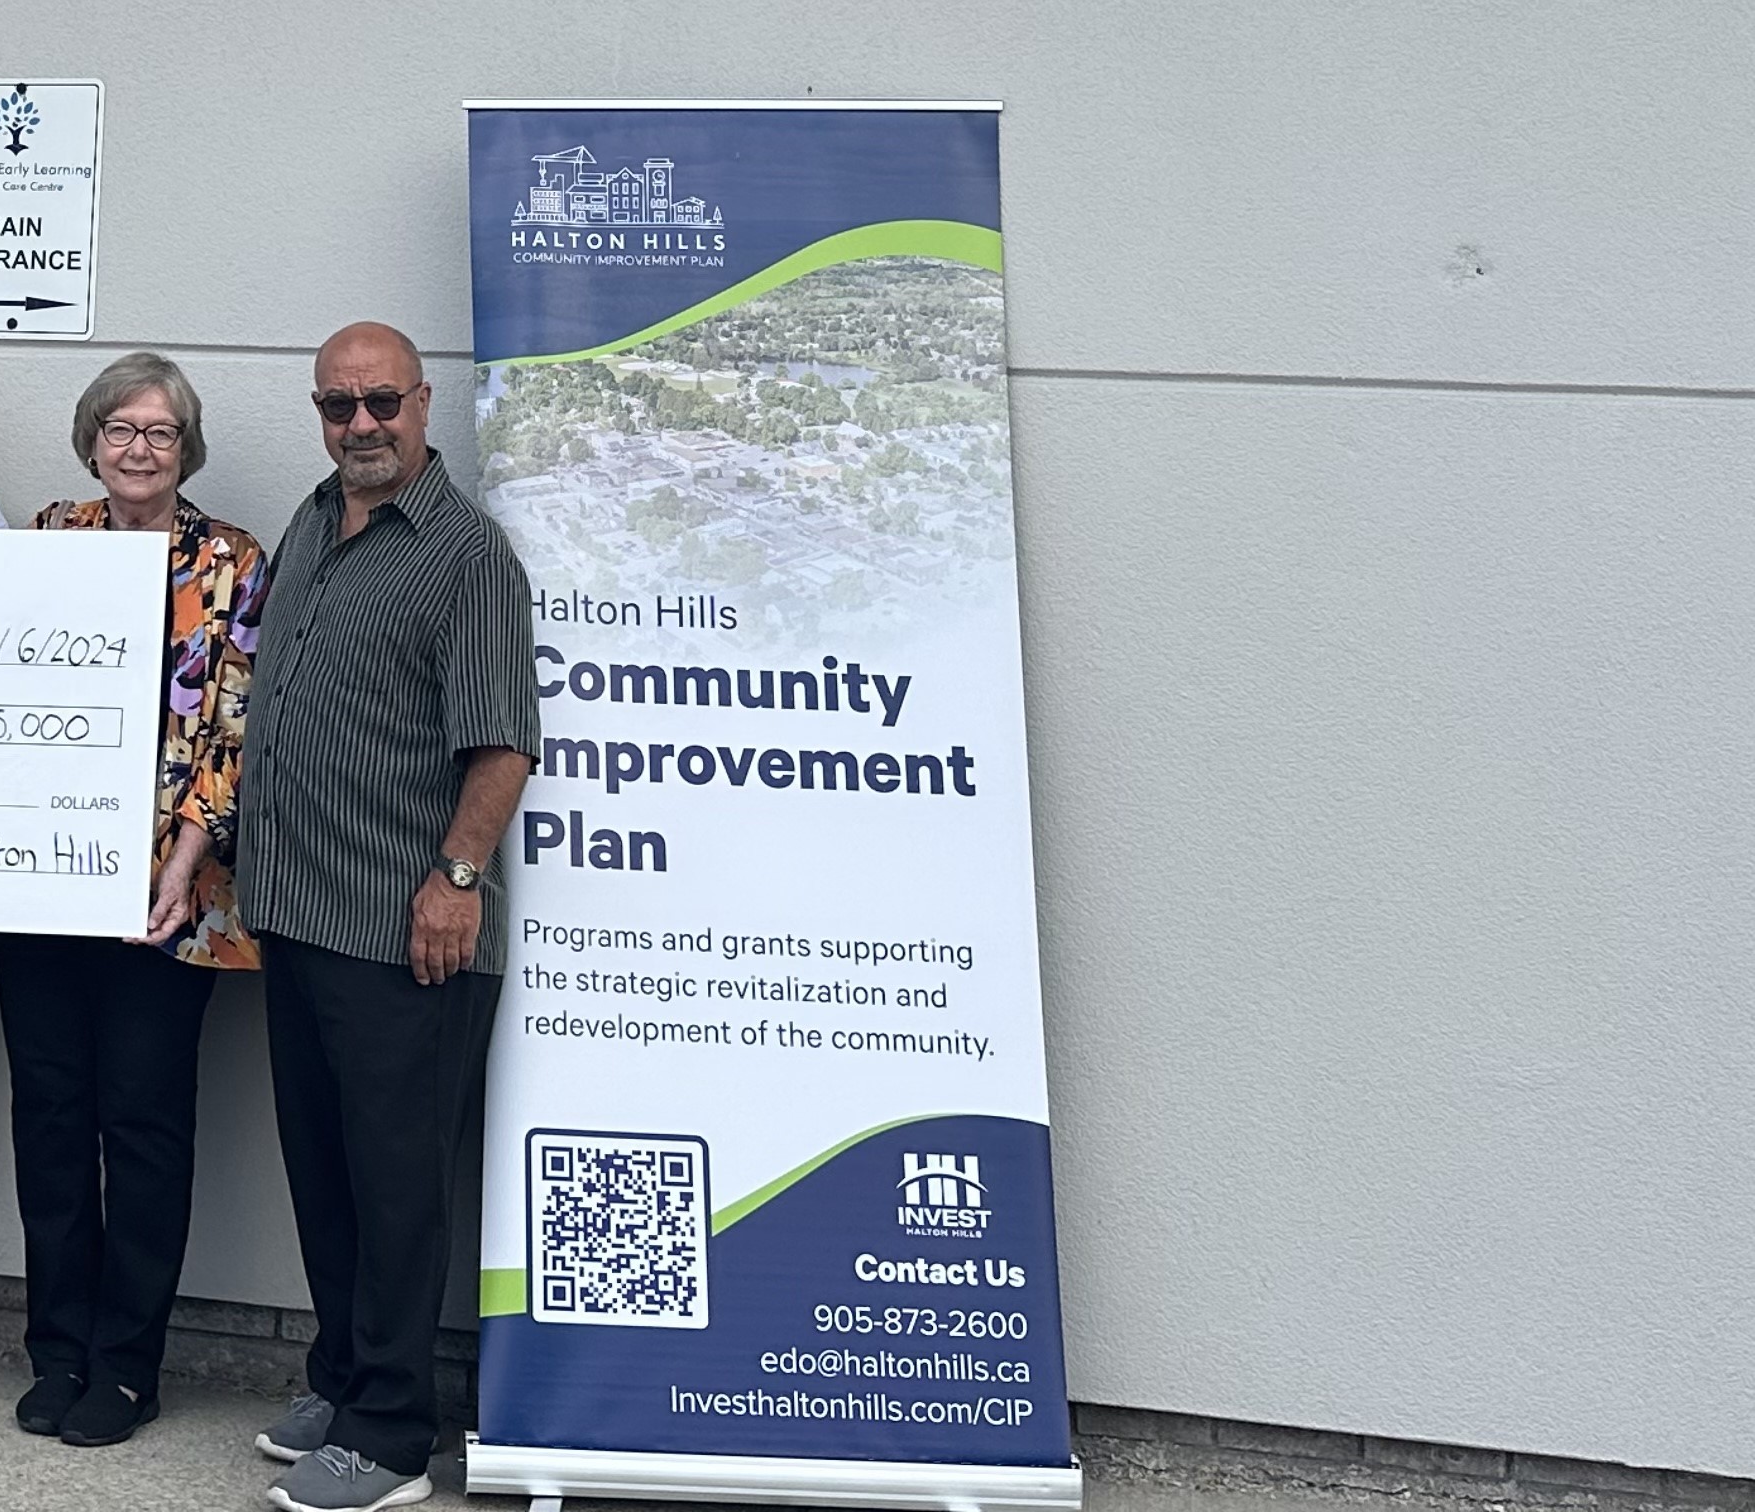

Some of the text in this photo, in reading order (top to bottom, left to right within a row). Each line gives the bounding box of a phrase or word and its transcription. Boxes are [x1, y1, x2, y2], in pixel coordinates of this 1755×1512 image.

[2, 181, 26, 191] Care
[30, 181, 64, 192] Centre
[34, 163, 92, 178] Learning
[511, 231, 726, 251] HALTON HILLS
[512, 252, 724, 267] COMMUNITY IMPROVEMENT PLAN
[656, 595, 738, 629] Hills
[534, 645, 912, 727] Community
[530, 736, 976, 796] mprovement
[51, 796, 120, 811] DOLLARS
[54, 832, 120, 876] Hills
[523, 811, 668, 872] Plan
[523, 919, 973, 969] Programs and grants supporting
[523, 966, 947, 1008] the strategic revitalization and
[525, 1012, 995, 1062] redevelopment of the community.
[897, 1206, 992, 1228] INVEST
[906, 1228, 982, 1238] HALTON HILLS
[854, 1253, 1026, 1288] Contact Us
[814, 1305, 1028, 1340] 905-873-2600
[760, 1348, 1031, 1383] edo@haltonhills.ca
[670, 1385, 1034, 1426] Investhaltonhills.com/CIP
